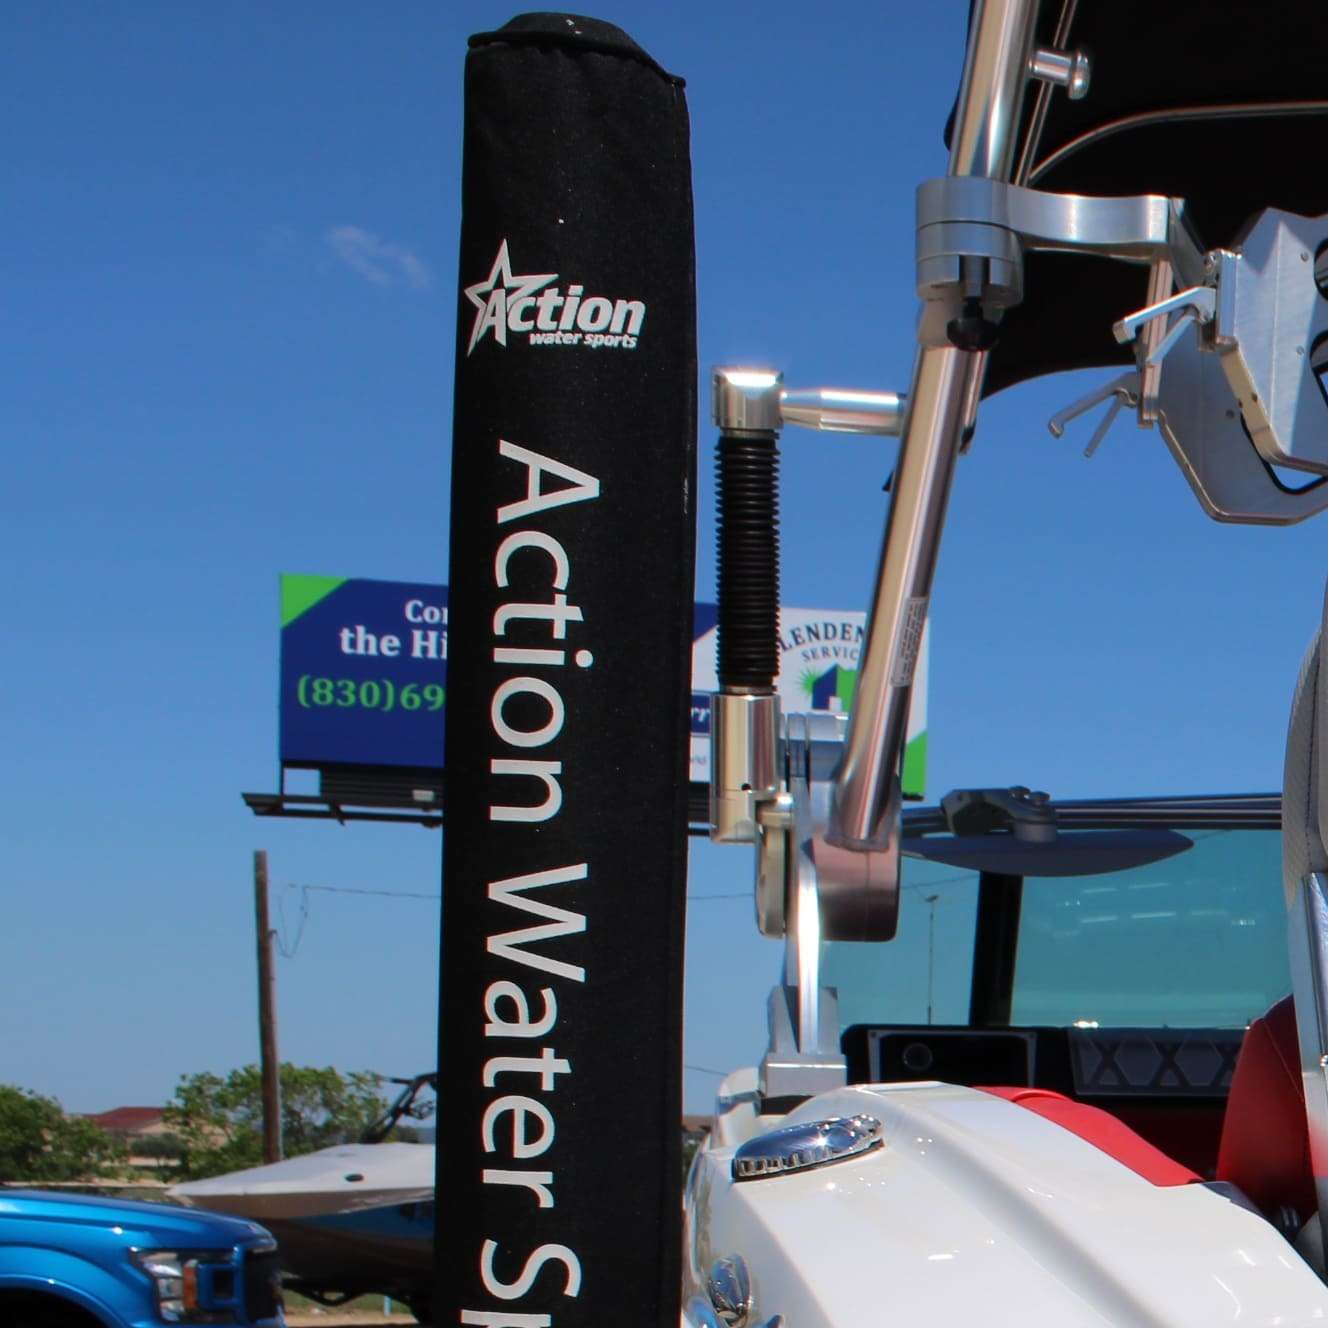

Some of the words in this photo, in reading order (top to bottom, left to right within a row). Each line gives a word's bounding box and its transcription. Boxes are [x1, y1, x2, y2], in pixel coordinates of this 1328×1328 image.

[529, 332, 582, 346] water
[583, 334, 638, 349] sports
[339, 625, 401, 657] the
[490, 440, 599, 822] Action
[483, 864, 587, 1208] Water
